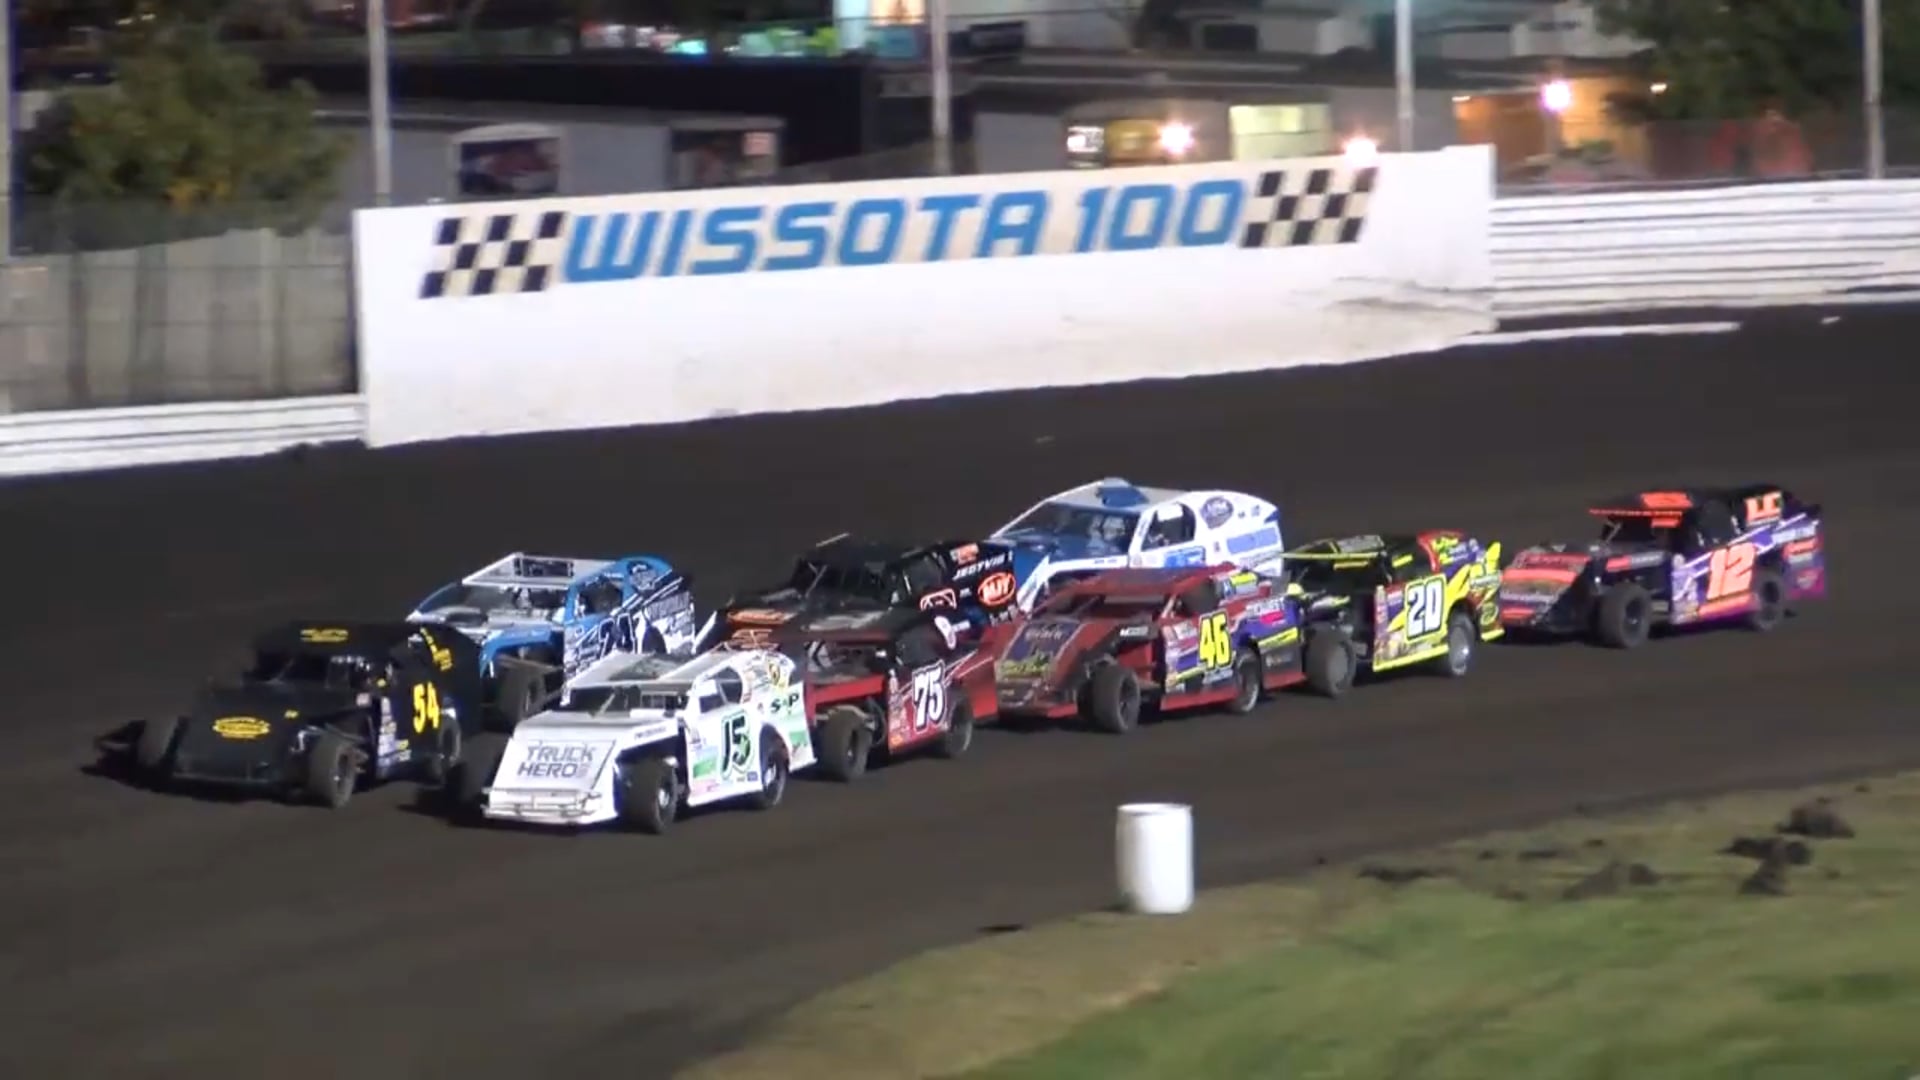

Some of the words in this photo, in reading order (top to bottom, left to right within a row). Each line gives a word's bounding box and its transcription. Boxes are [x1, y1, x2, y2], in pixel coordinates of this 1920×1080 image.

[562, 190, 1048, 282] WISSOTA
[1076, 179, 1247, 253] 100
[1706, 542, 1755, 600] 12
[1406, 577, 1444, 640] 20
[1200, 612, 1232, 669] 46
[413, 682, 440, 733] 54
[912, 665, 945, 730] 75
[517, 762, 578, 778] HERO
[527, 744, 597, 763] TRUCK
[722, 715, 751, 773] 15
